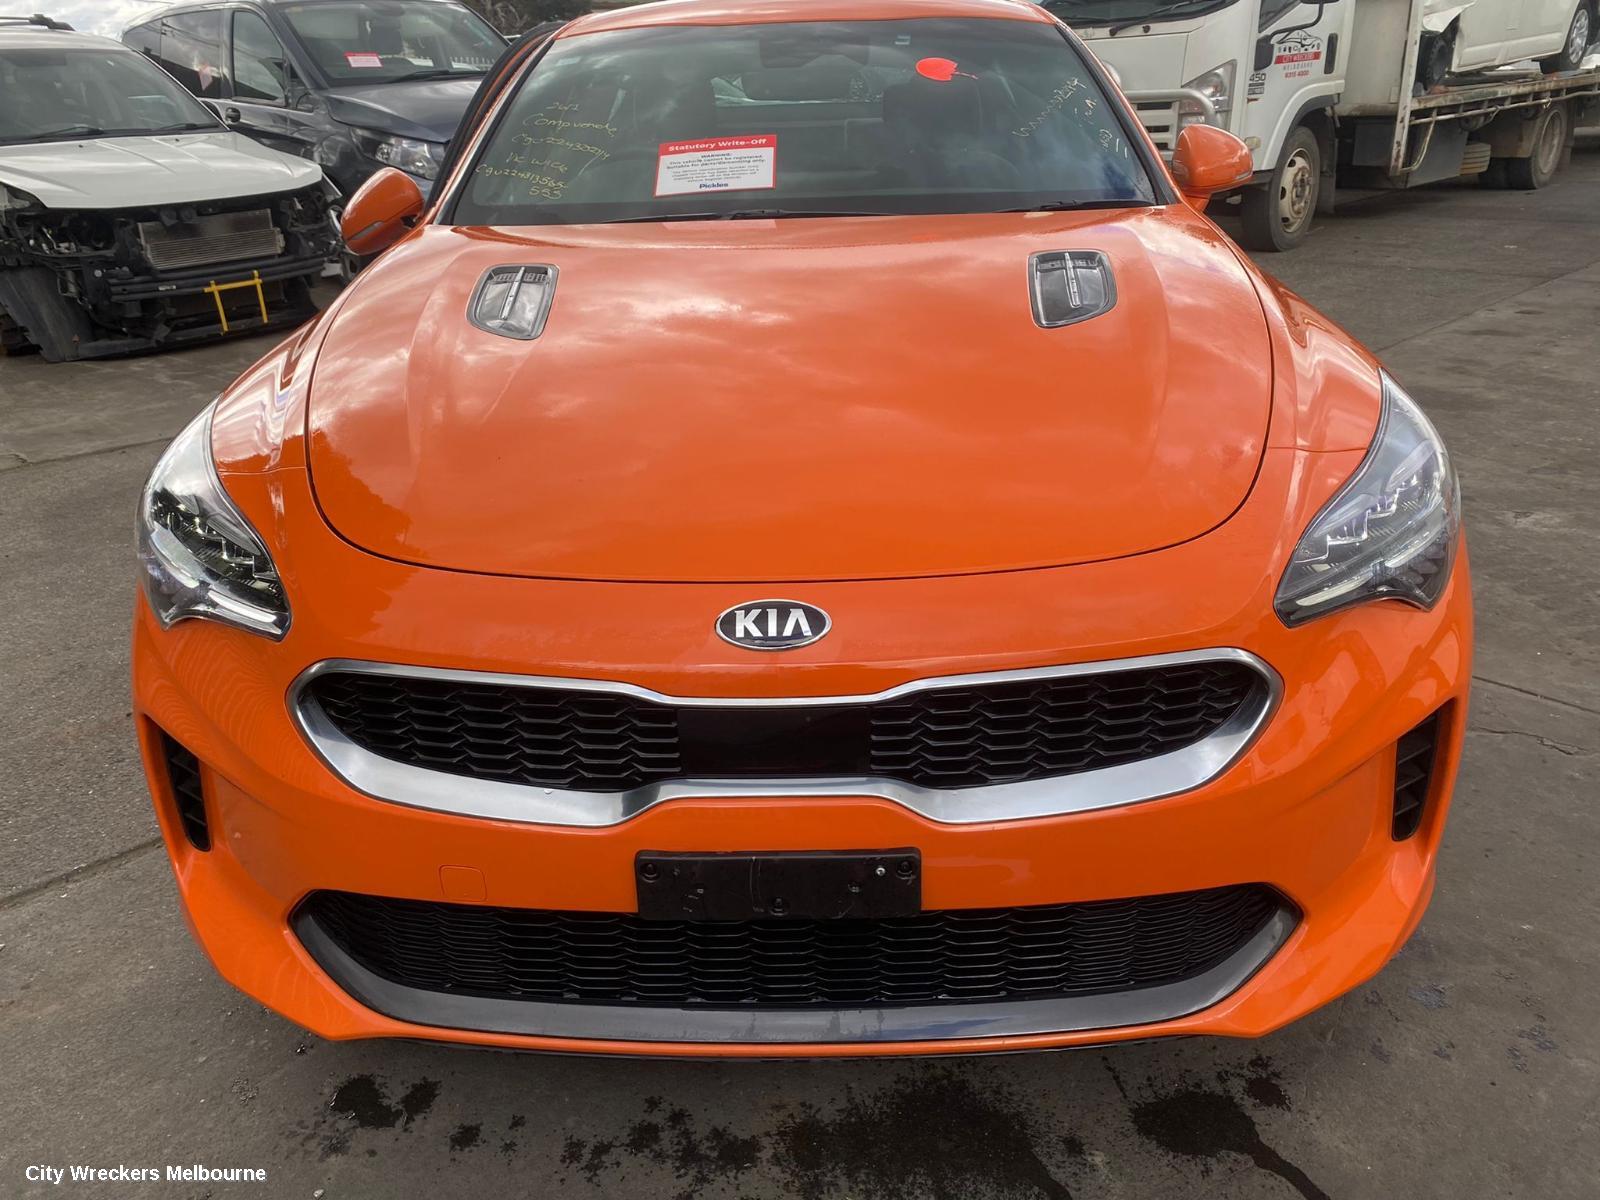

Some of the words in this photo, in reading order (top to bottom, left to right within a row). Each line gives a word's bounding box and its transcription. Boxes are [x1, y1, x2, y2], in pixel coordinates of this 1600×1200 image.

[1249, 73, 1267, 81] 450
[668, 142, 715, 152] Statutory
[718, 138, 767, 147] Write-Off
[734, 608, 813, 638] KIA
